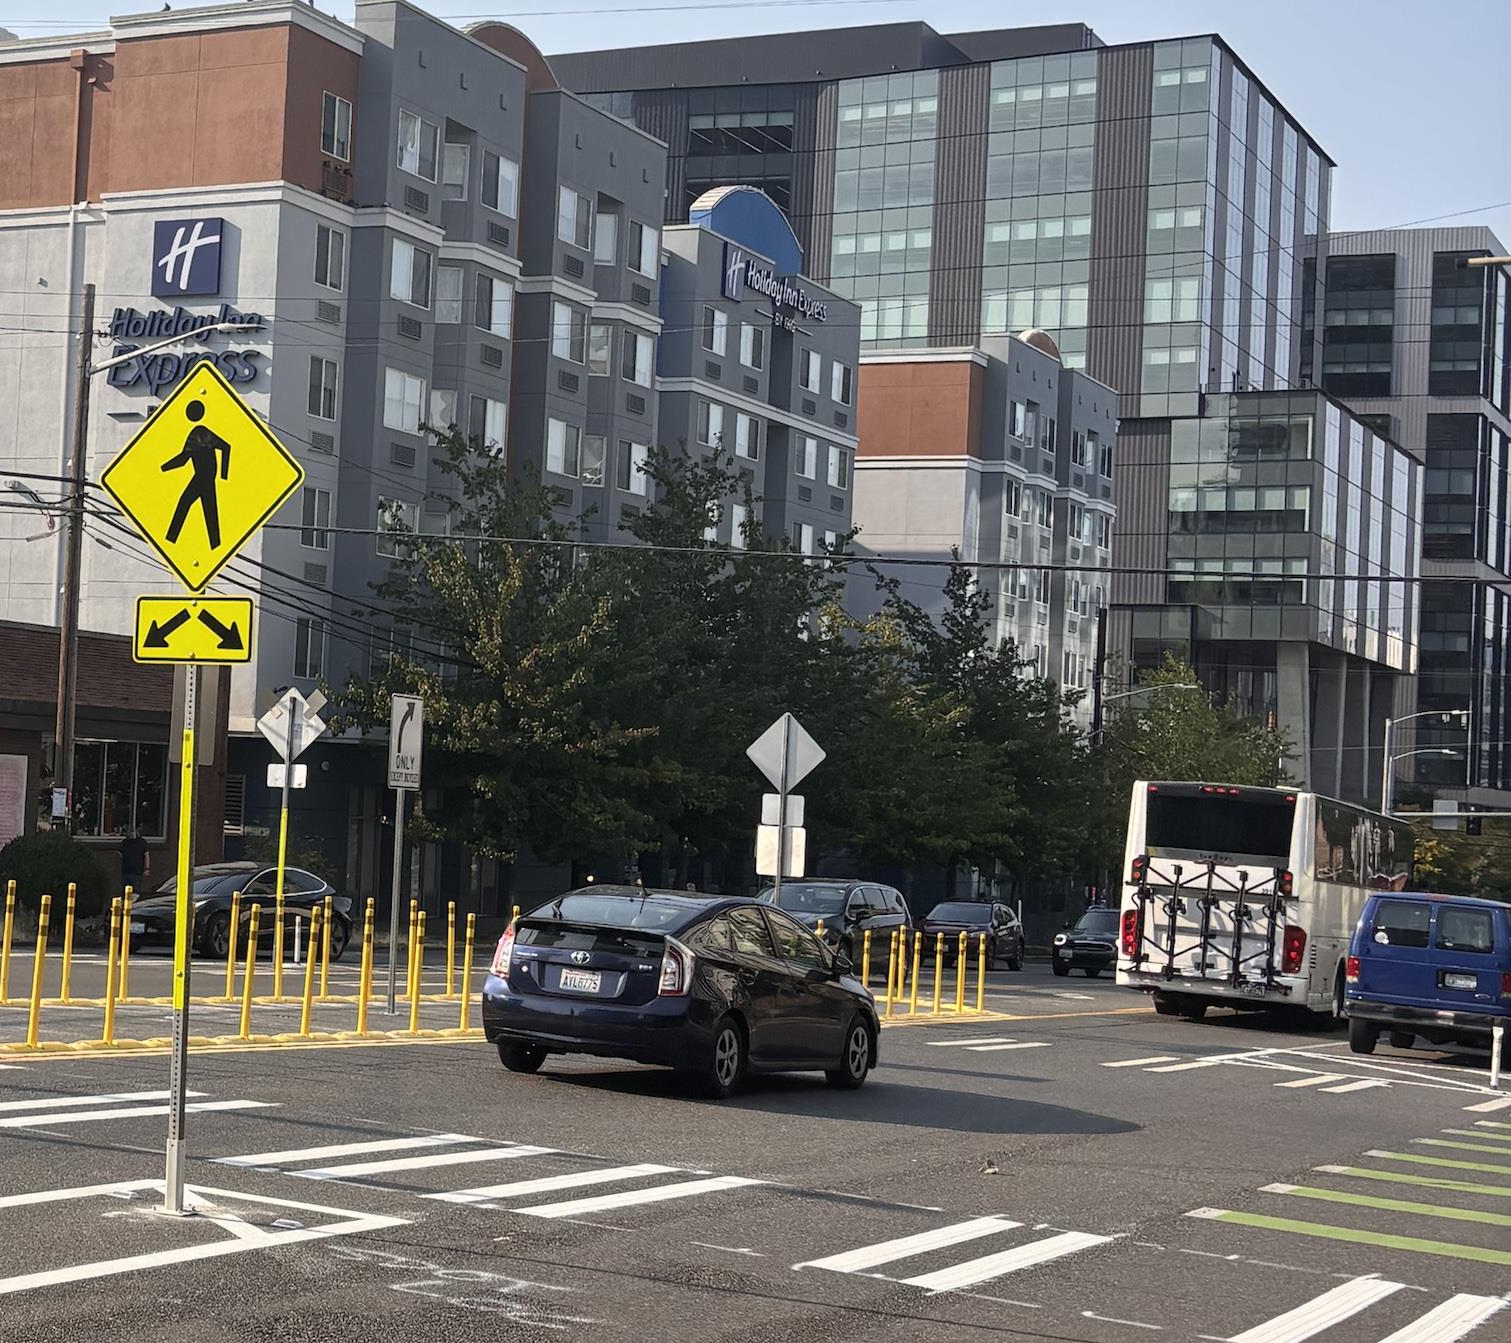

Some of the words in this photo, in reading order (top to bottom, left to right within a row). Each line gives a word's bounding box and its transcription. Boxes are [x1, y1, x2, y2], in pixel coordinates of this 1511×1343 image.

[748, 260, 783, 306] Holiday
[783, 277, 798, 307] Inn
[798, 289, 827, 321] Express
[109, 307, 217, 342] Holiday
[217, 304, 262, 332] Inn
[395, 754, 416, 770] ONLY
